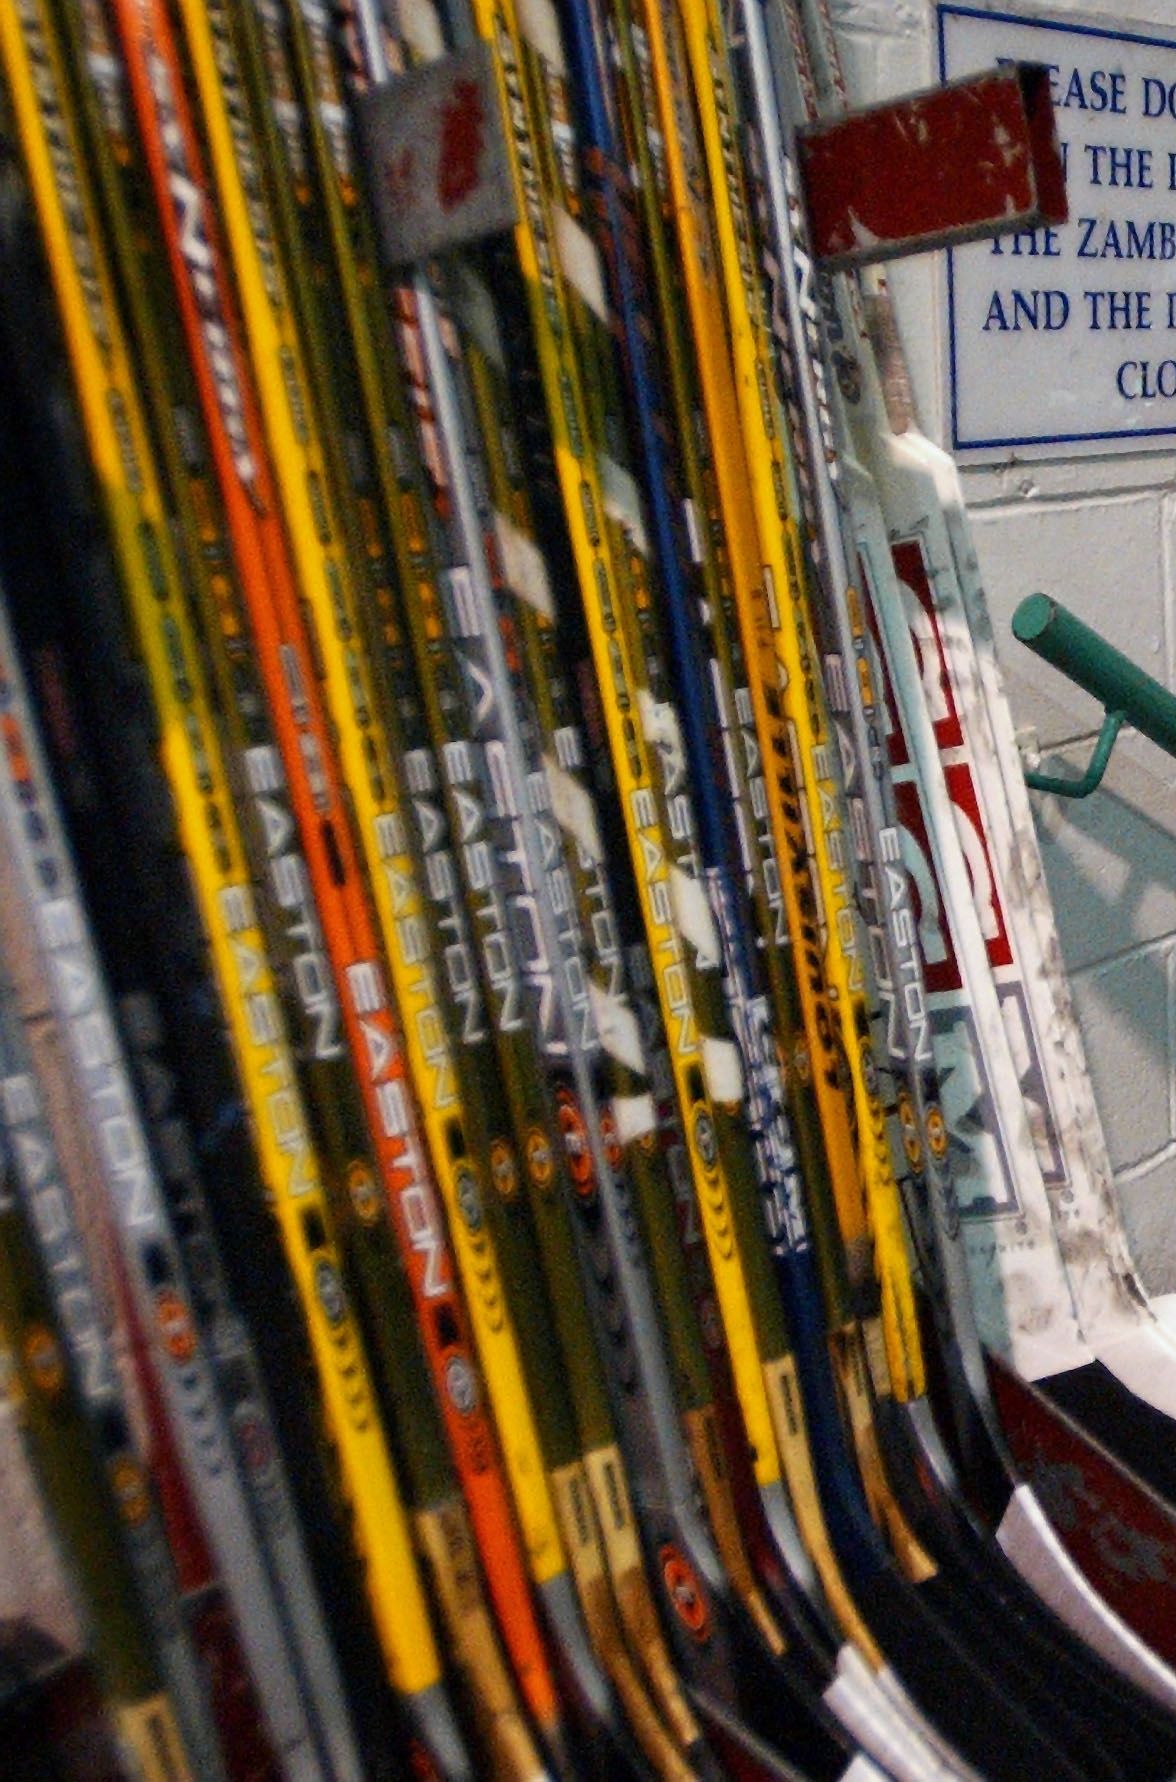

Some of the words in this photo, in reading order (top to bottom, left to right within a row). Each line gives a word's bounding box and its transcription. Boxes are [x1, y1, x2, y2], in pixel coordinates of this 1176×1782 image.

[996, 57, 1127, 114] EASE
[1084, 144, 1153, 189] THE
[982, 289, 1070, 331] AND
[1084, 291, 1151, 330] THE
[245, 744, 344, 1060] EASTON
[405, 748, 486, 1045] EASTON
[442, 740, 525, 1031] EASTON
[527, 771, 598, 1050] EASTON
[629, 787, 700, 1055] EASTON
[735, 688, 787, 947] EASTON
[811, 744, 866, 995] EASTON
[824, 654, 906, 1058] EASTON
[879, 827, 932, 1063] EASTON
[218, 884, 321, 1199] EASTON
[372, 811, 457, 1114] EASTON
[346, 961, 451, 1299] EASTON
